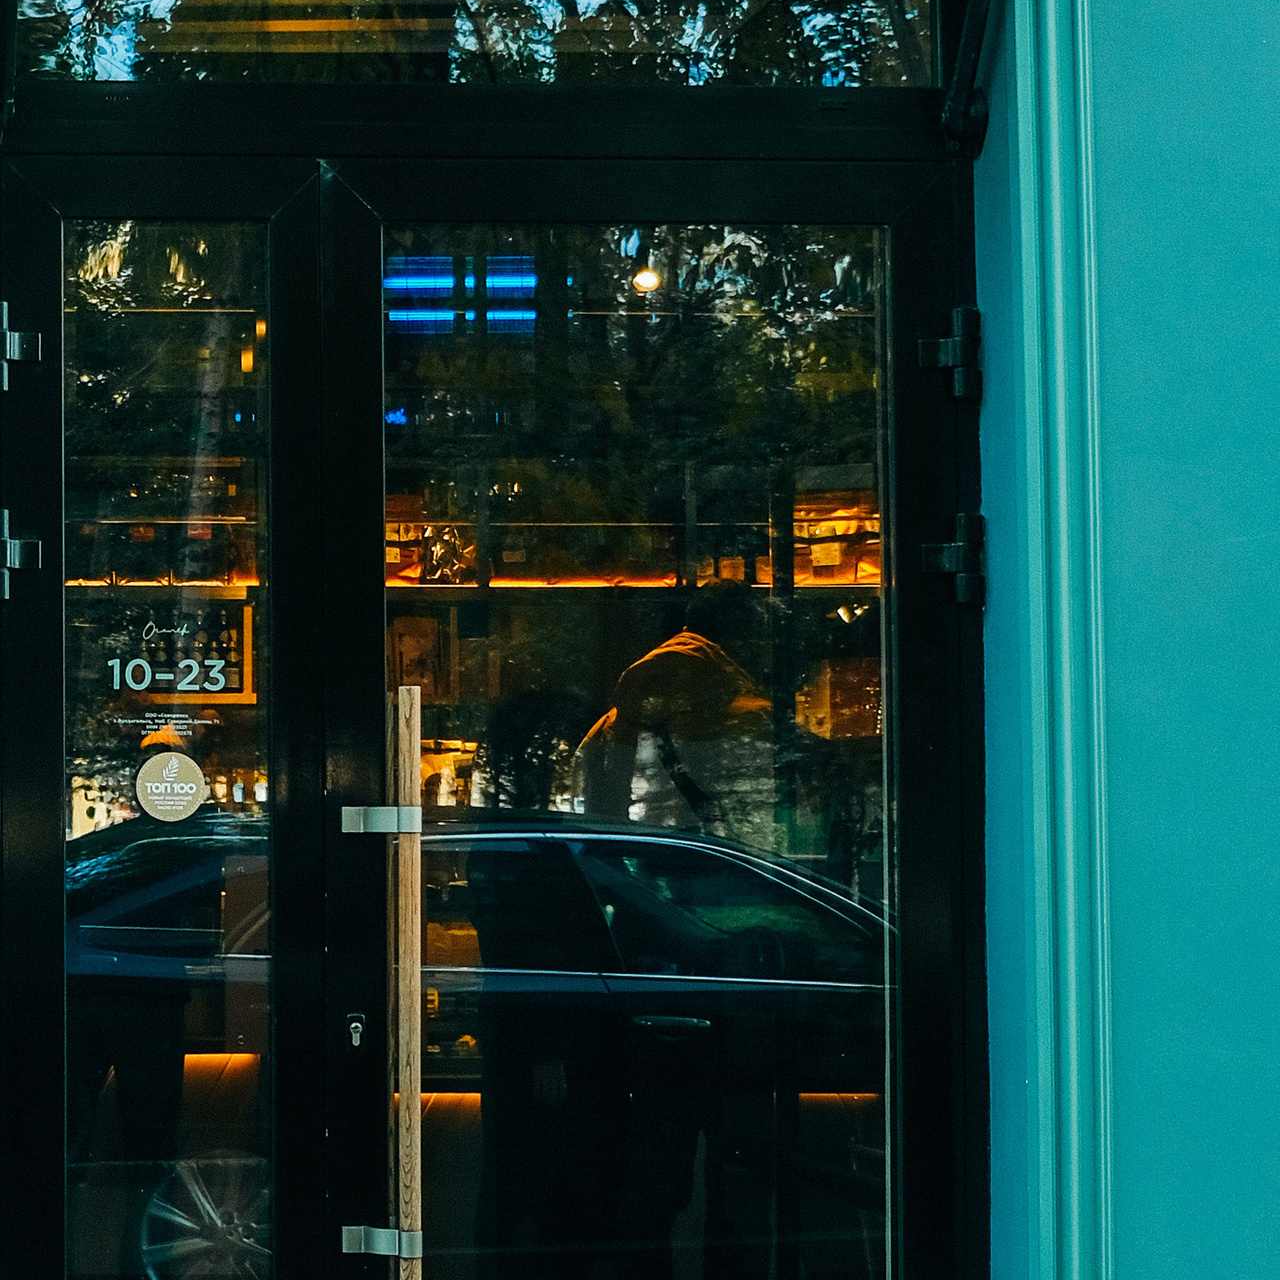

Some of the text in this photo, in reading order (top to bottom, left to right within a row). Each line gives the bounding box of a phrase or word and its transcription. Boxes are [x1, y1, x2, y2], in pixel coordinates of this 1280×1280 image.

[107, 658, 226, 692] 10-23
[145, 782, 197, 795] ТОП 100
